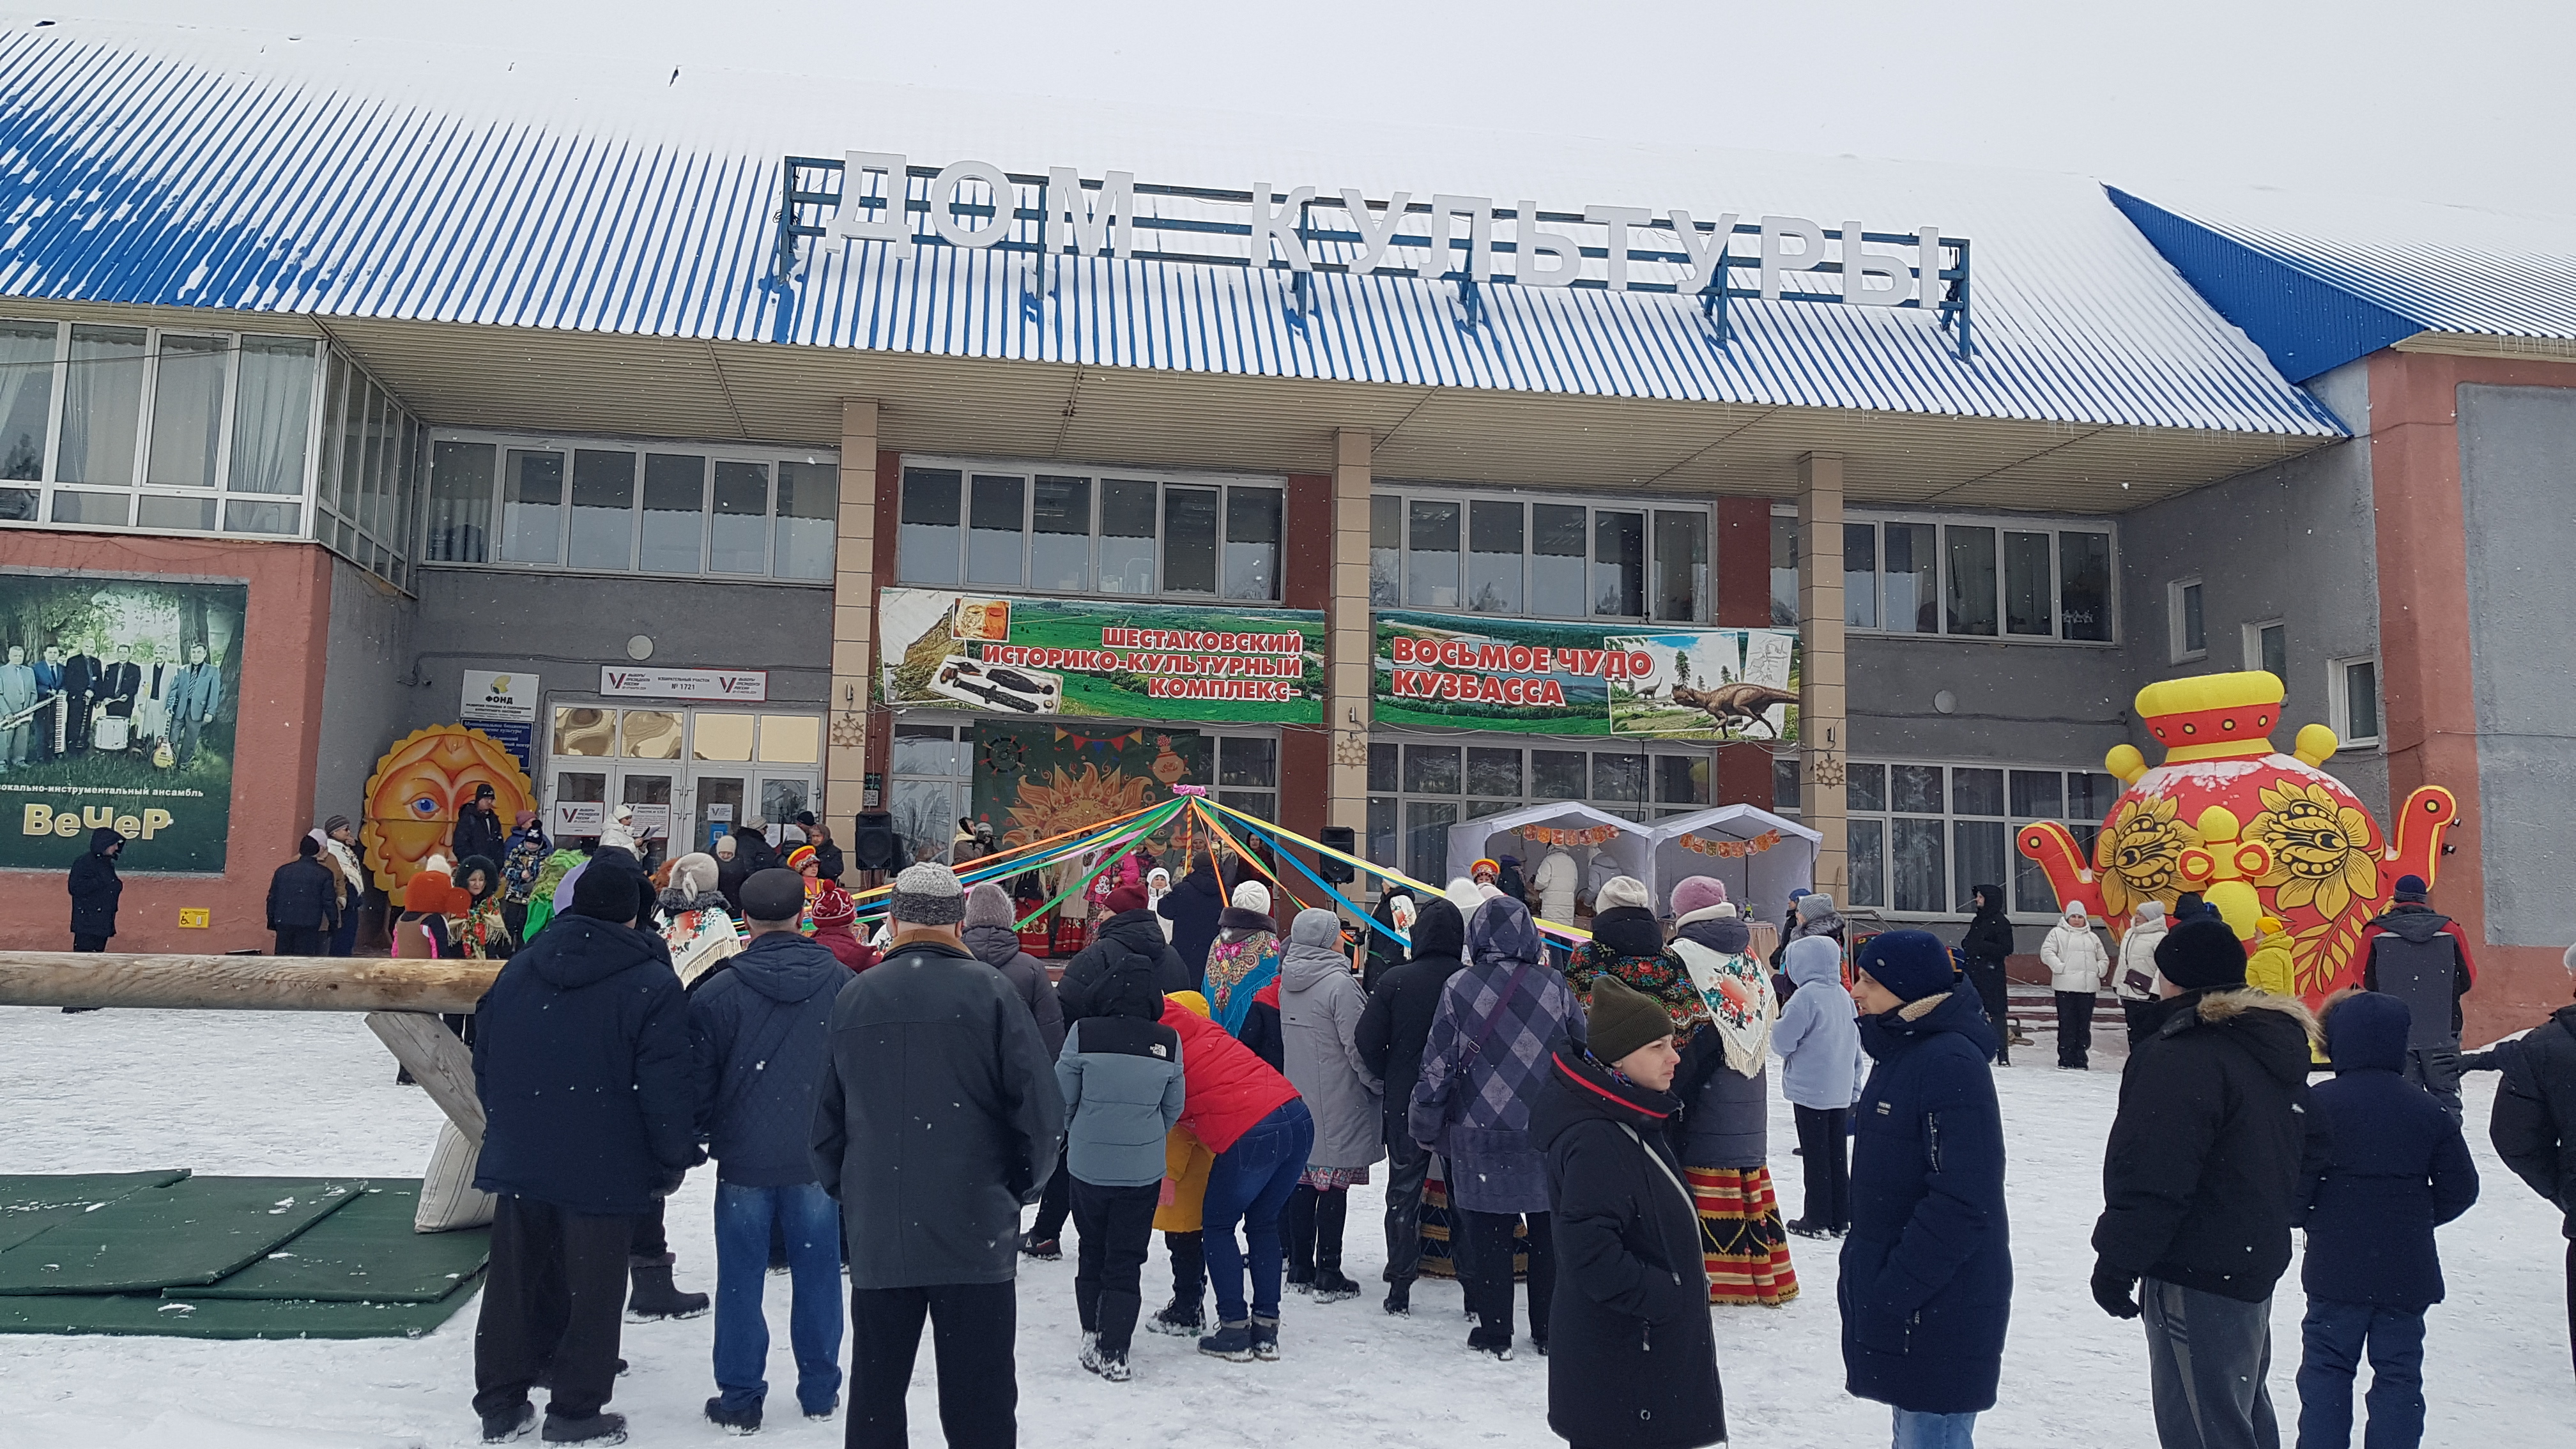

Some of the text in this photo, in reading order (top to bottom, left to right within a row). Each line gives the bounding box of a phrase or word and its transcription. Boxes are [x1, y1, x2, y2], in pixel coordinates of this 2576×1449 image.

[825, 151, 1940, 309] ДОМ КУЛЬТУРЫ
[1102, 627, 1303, 655] ШЕСТАКОВСКИЙ
[982, 644, 1303, 678] ИСТОРИКО-КУЛЬТУРНЫЙ
[1393, 636, 1655, 681] ВОСЬМОЕ ЧУДО
[486, 695, 513, 705] ФОНД
[1392, 669, 1567, 707] КУЗБАССА
[152, 787, 204, 797] ансамбль
